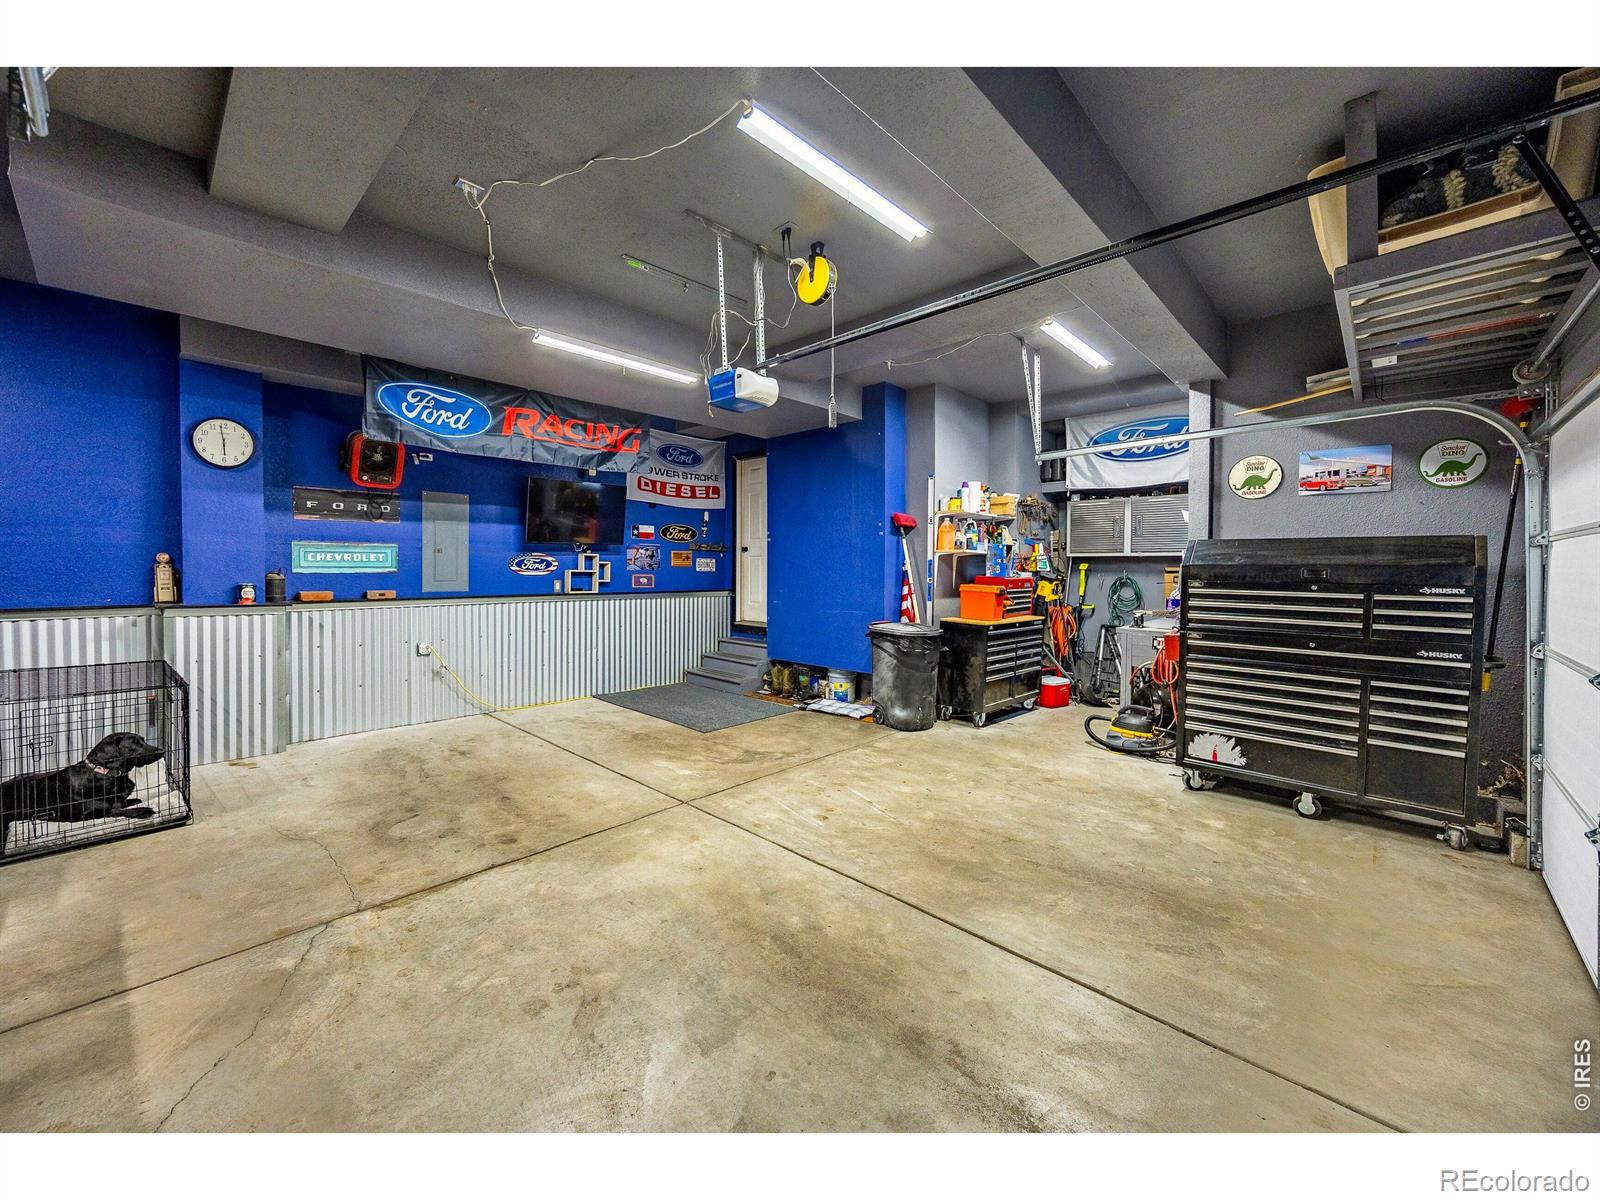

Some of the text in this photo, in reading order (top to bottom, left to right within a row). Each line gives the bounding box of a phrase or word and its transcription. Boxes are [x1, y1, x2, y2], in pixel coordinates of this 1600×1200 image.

[402, 388, 643, 453] Ford RACING
[667, 447, 693, 464] Ford
[681, 472, 719, 482] STROKE
[640, 477, 719, 498] DIESEL
[666, 525, 692, 541] Ford
[307, 552, 385, 562] CHEVROLET
[521, 558, 547, 570] Ford
[1431, 587, 1466, 595] HUSKY
[1428, 651, 1463, 660] HUSKY
